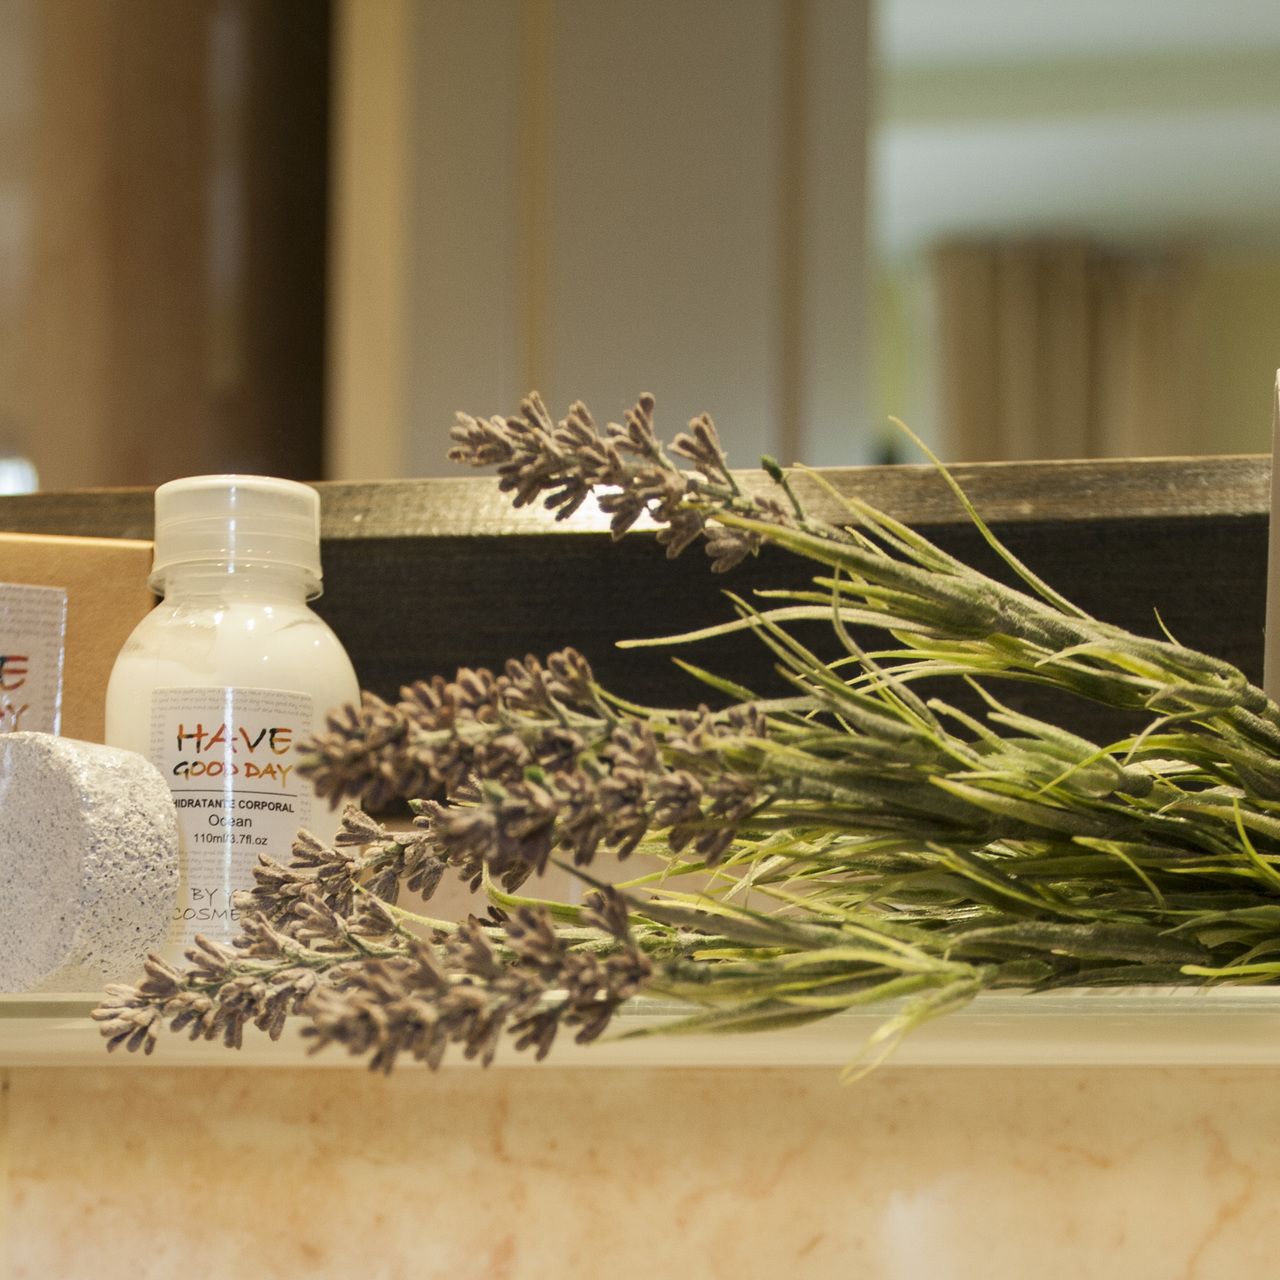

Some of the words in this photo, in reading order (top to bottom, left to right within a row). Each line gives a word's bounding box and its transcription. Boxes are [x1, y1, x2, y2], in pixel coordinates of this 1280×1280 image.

[176, 723, 293, 755] HAVE
[173, 760, 238, 780] GOOD
[244, 763, 294, 788] DAY
[238, 800, 295, 813] CORPORAL
[208, 813, 253, 828] Ocean
[191, 887, 218, 906] BY
